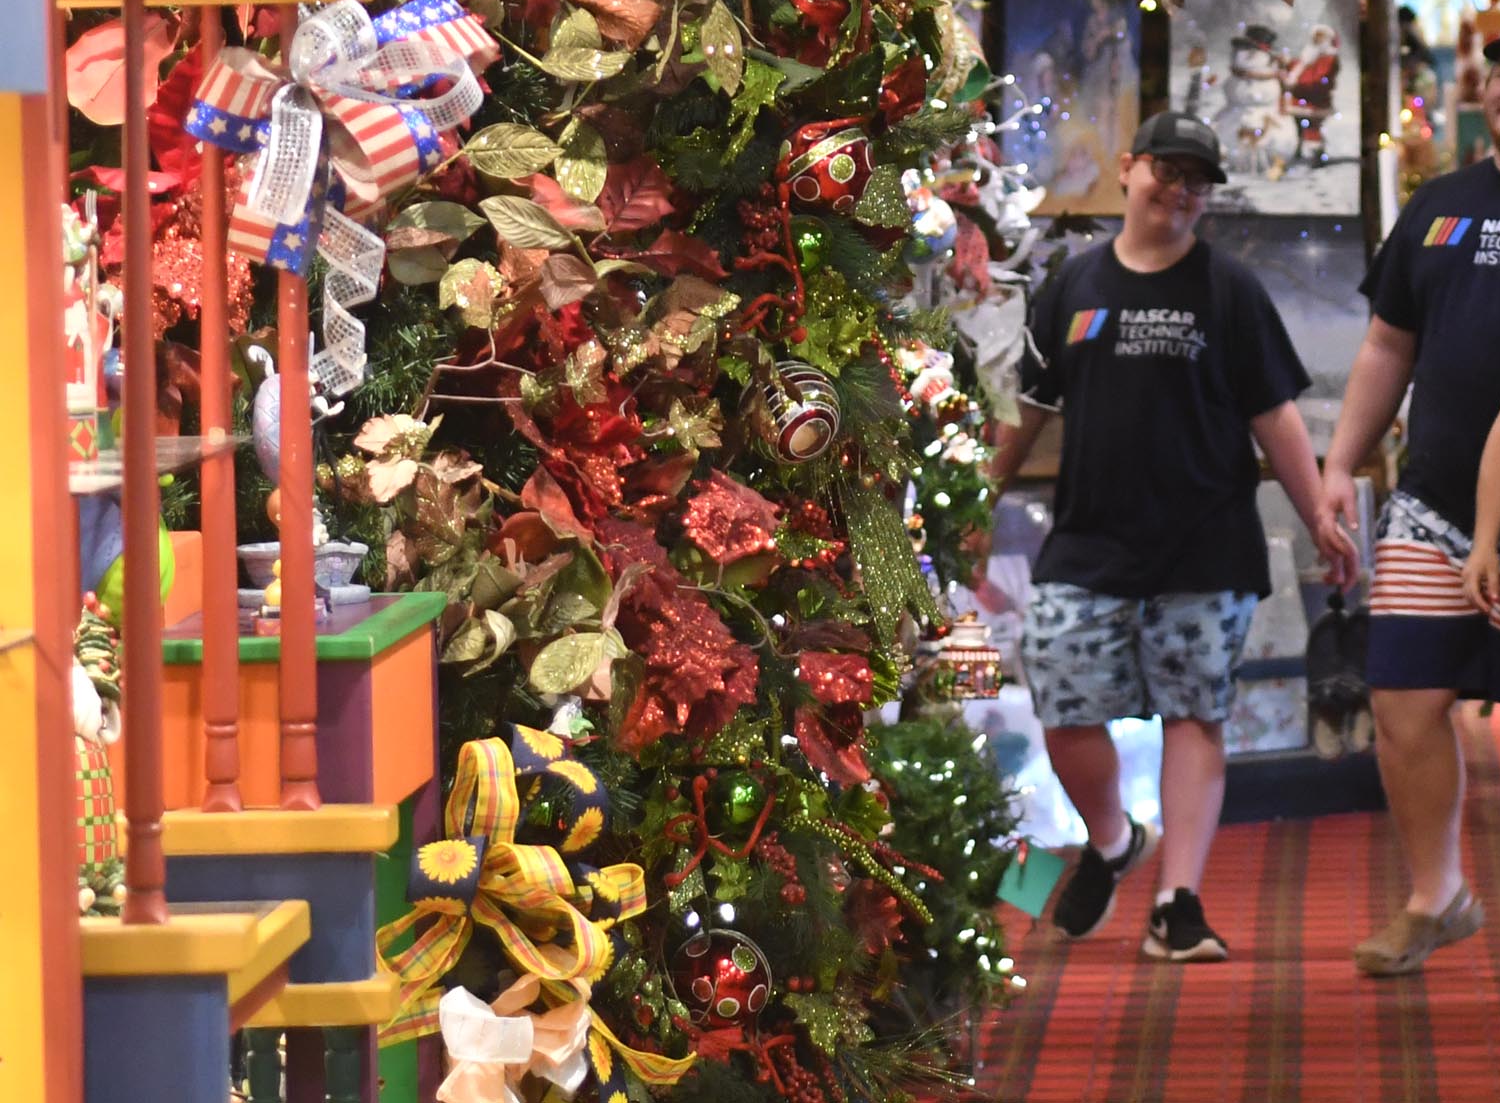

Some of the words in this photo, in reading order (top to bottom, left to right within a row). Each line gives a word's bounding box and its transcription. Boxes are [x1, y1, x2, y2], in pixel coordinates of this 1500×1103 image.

[1119, 308, 1195, 326] NASCAR
[1119, 324, 1208, 347] TECHNICAL
[1115, 340, 1200, 361] INSTITUTE
